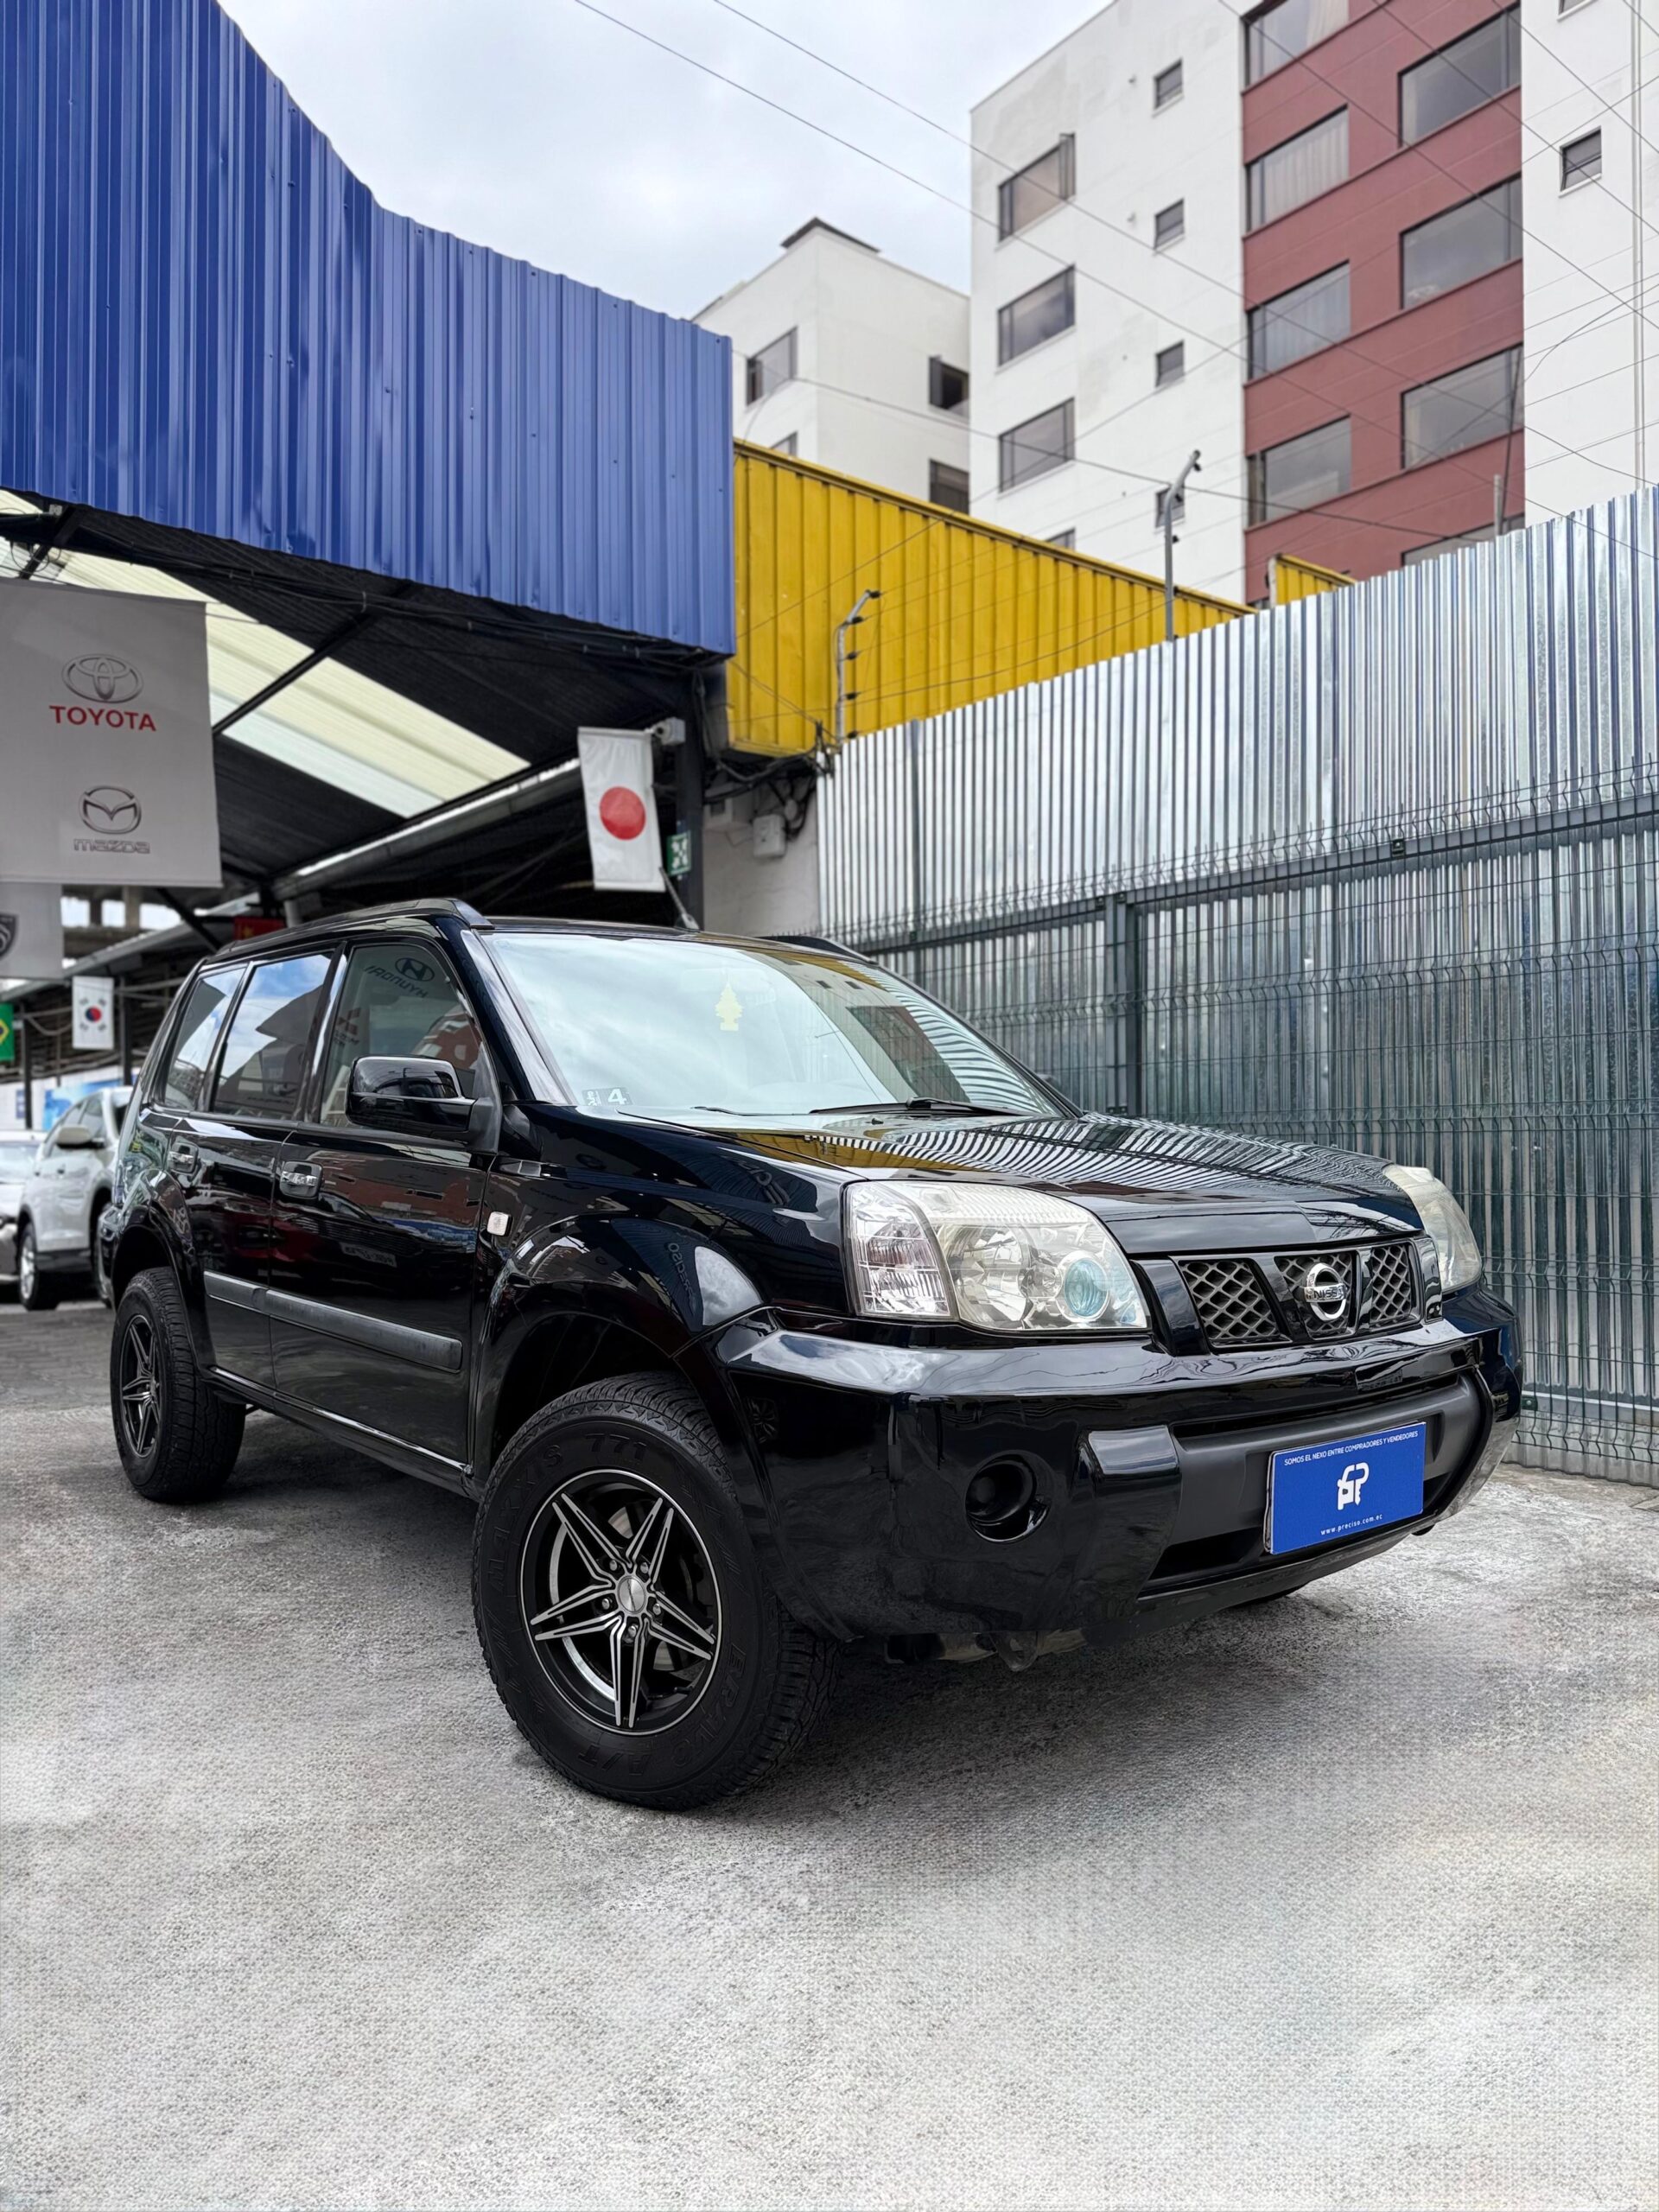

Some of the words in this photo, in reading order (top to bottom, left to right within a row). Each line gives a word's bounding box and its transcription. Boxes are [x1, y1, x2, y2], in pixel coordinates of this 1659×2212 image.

[49, 704, 156, 732] TOYOTA
[607, 1088, 627, 1105] 4
[1284, 1455, 1305, 1466] SOMOS
[1313, 1451, 1327, 1460] NEXO
[1327, 1447, 1344, 1457] ENTRE
[1344, 1439, 1382, 1453] COMPRADORES
[1386, 1430, 1419, 1443] VENDEDORES
[1320, 1514, 1382, 1535] www.preciso.com.ec
